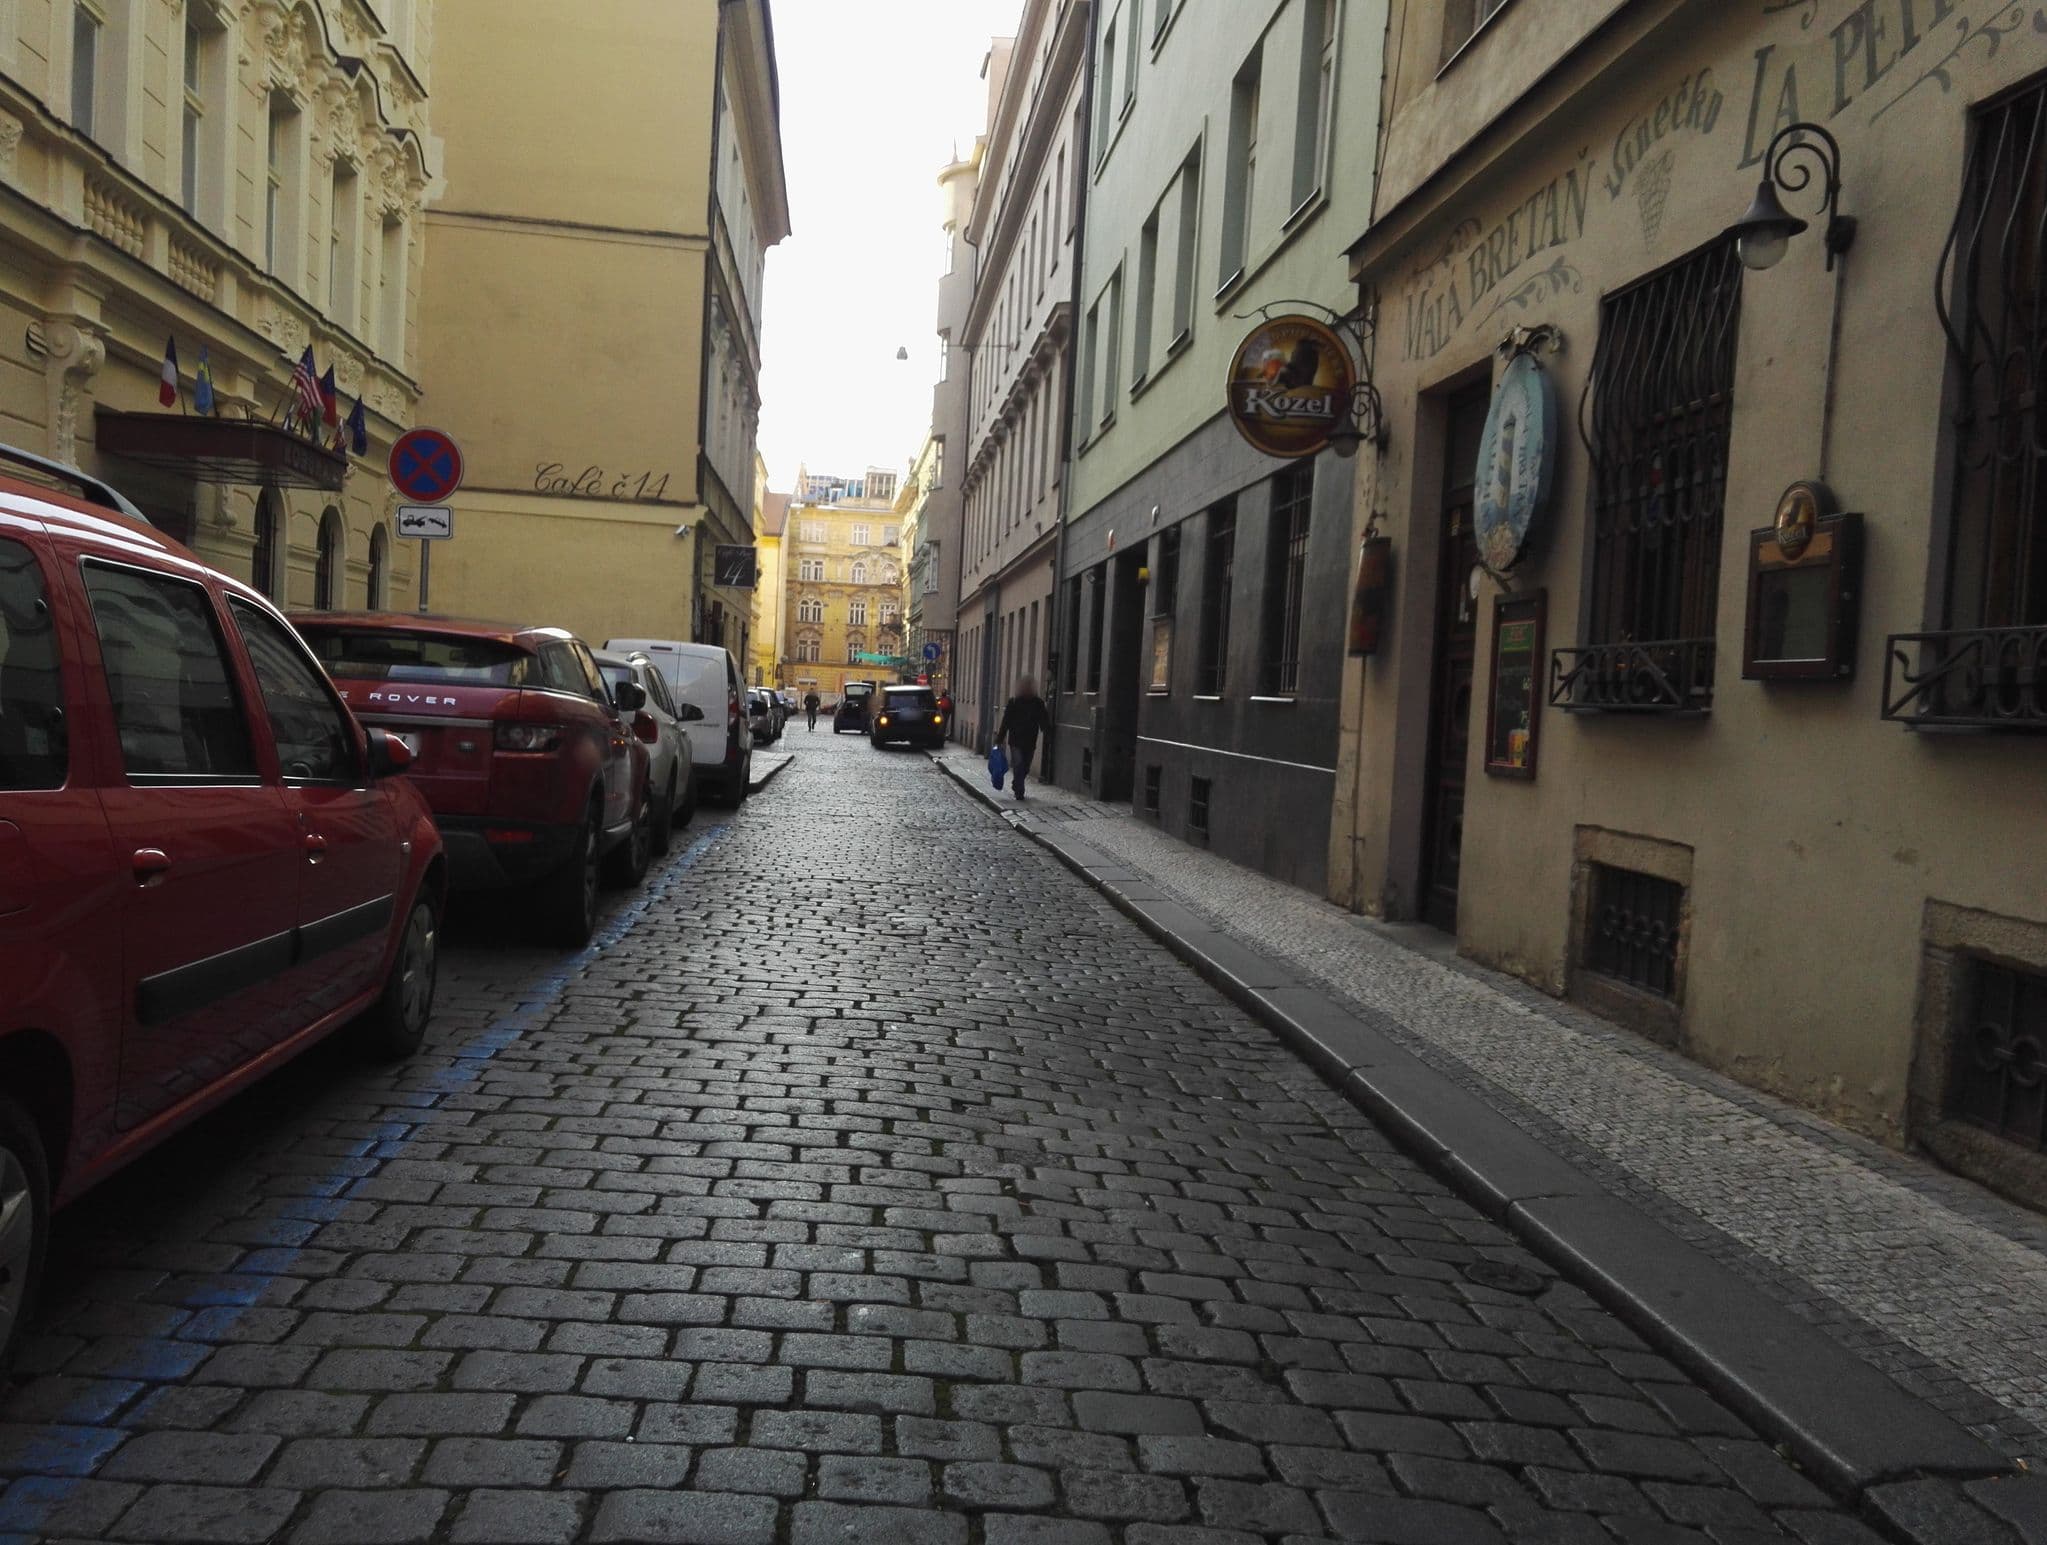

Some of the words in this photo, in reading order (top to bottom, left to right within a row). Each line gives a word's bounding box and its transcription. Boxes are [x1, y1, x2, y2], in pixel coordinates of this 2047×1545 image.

[1468, 146, 1595, 308] BRETAŇ
[1244, 388, 1335, 419] Kozel
[534, 463, 604, 497] Café
[369, 692, 457, 706] ROVER
